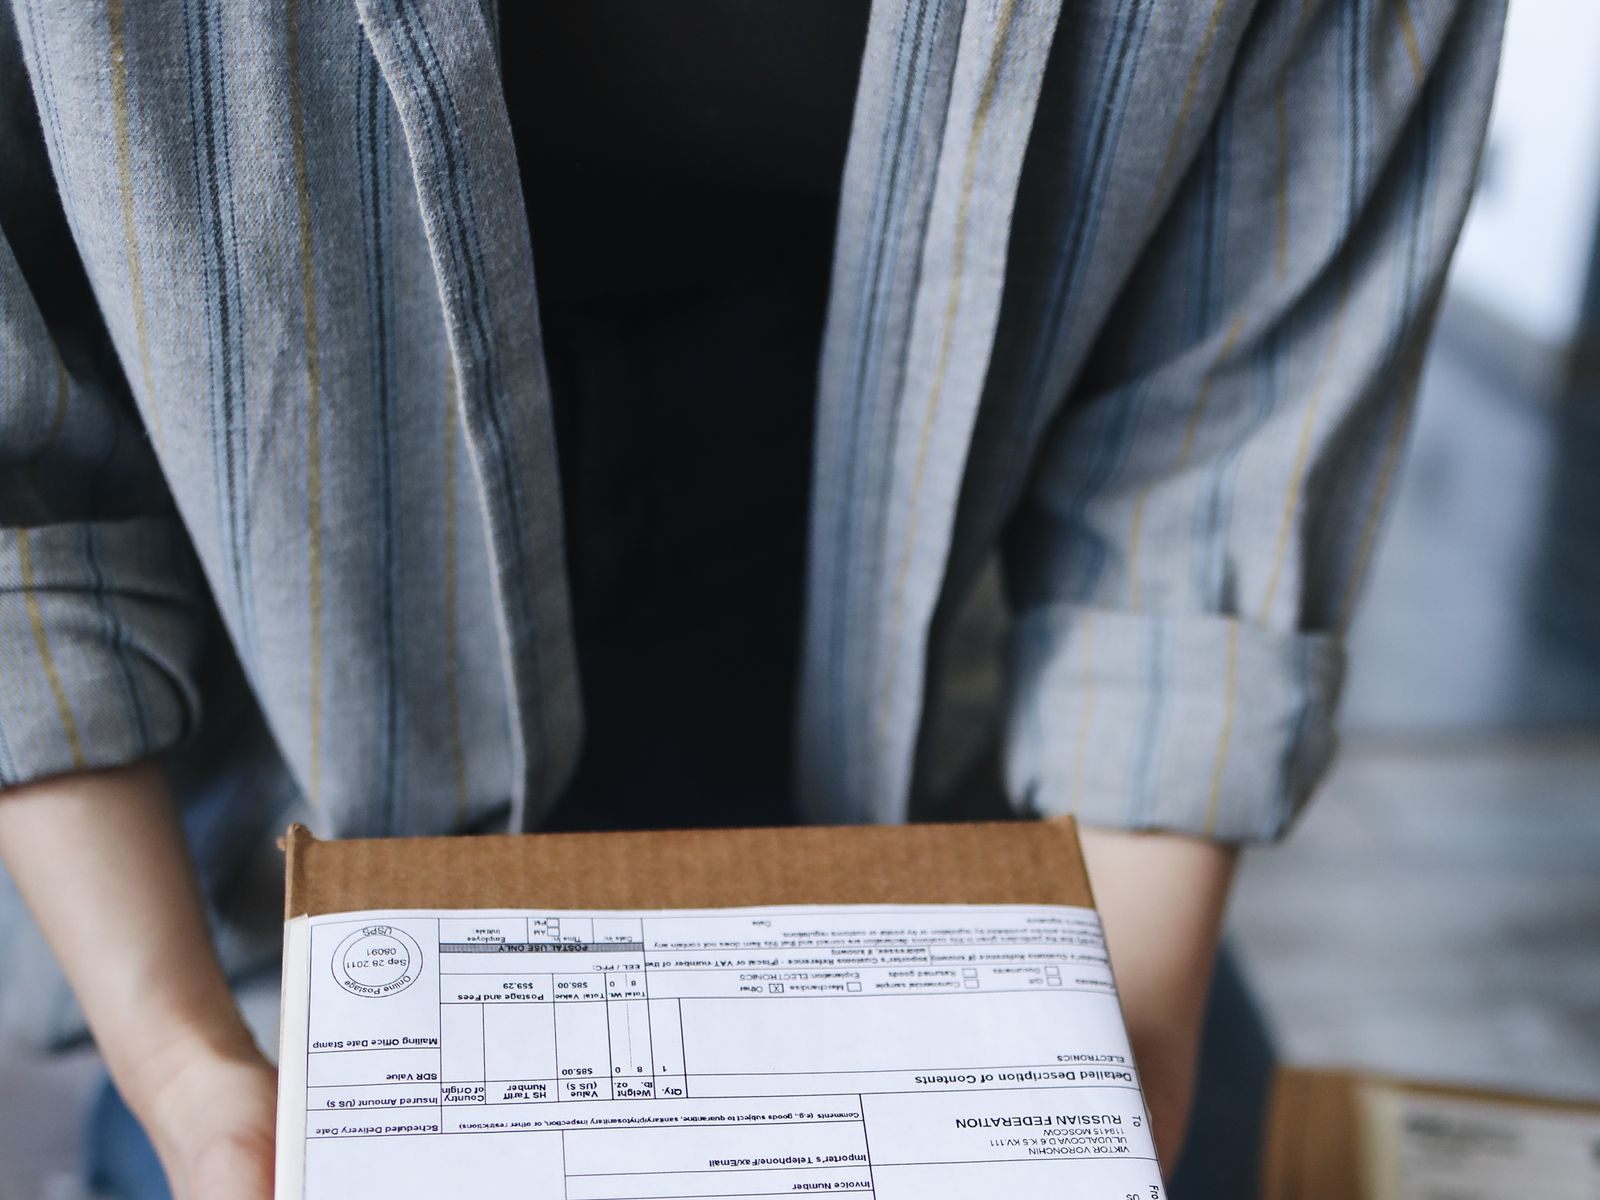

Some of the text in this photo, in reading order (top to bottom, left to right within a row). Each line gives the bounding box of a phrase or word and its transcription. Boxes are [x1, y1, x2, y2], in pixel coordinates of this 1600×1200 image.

[362, 925, 392, 937] USPS
[466, 935, 506, 943] Employee
[366, 947, 397, 956] 08091
[498, 944, 588, 952] POSTAL USE ONLY
[346, 957, 407, 969] Sep 28 2011
[739, 972, 808, 981] ELECTRONICS
[344, 975, 412, 995] Online Postage
[502, 982, 534, 990] $59.29
[739, 985, 764, 993] Other
[789, 983, 845, 992] Merchandise
[457, 992, 544, 1002] Postage and Fees
[583, 992, 604, 1000] Total
[624, 990, 645, 998] Total
[312, 1036, 438, 1050] Mailing Office Date Stamp
[1056, 1054, 1125, 1064] ELECTRONICS
[561, 1067, 593, 1076] $85.00
[614, 1066, 643, 1074] 8 0
[662, 1065, 668, 1073] 1
[385, 1072, 438, 1082] SDR Value
[914, 1070, 1132, 1086] Detailed Description of Contents
[506, 1084, 546, 1093] Number
[566, 1081, 598, 1091] (US $)
[640, 1081, 653, 1089] lb.
[441, 1086, 484, 1096] of Origin
[503, 1090, 547, 1100] HS Tariff
[570, 1090, 598, 1099] Value
[617, 1086, 682, 1098] Qty. Weight
[443, 1092, 485, 1102] Country
[326, 1097, 438, 1109] Insured Amount (US $)
[736, 1112, 766, 1122] subject
[767, 1112, 793, 1121] goods
[817, 1112, 859, 1120] Comments
[458, 1121, 509, 1130] restrictions)
[955, 1114, 1122, 1128] RUSSIAN FEDERATION
[1132, 1115, 1141, 1128] To
[315, 1123, 439, 1136] Scheduled Delivery Date
[1042, 1128, 1091, 1137] MOSCOW
[1028, 1146, 1130, 1155] VIKTOR VORONCHIN
[709, 1153, 866, 1168] Importer's Telephone/Fax/Email
[792, 1181, 871, 1192] Invoice Number
